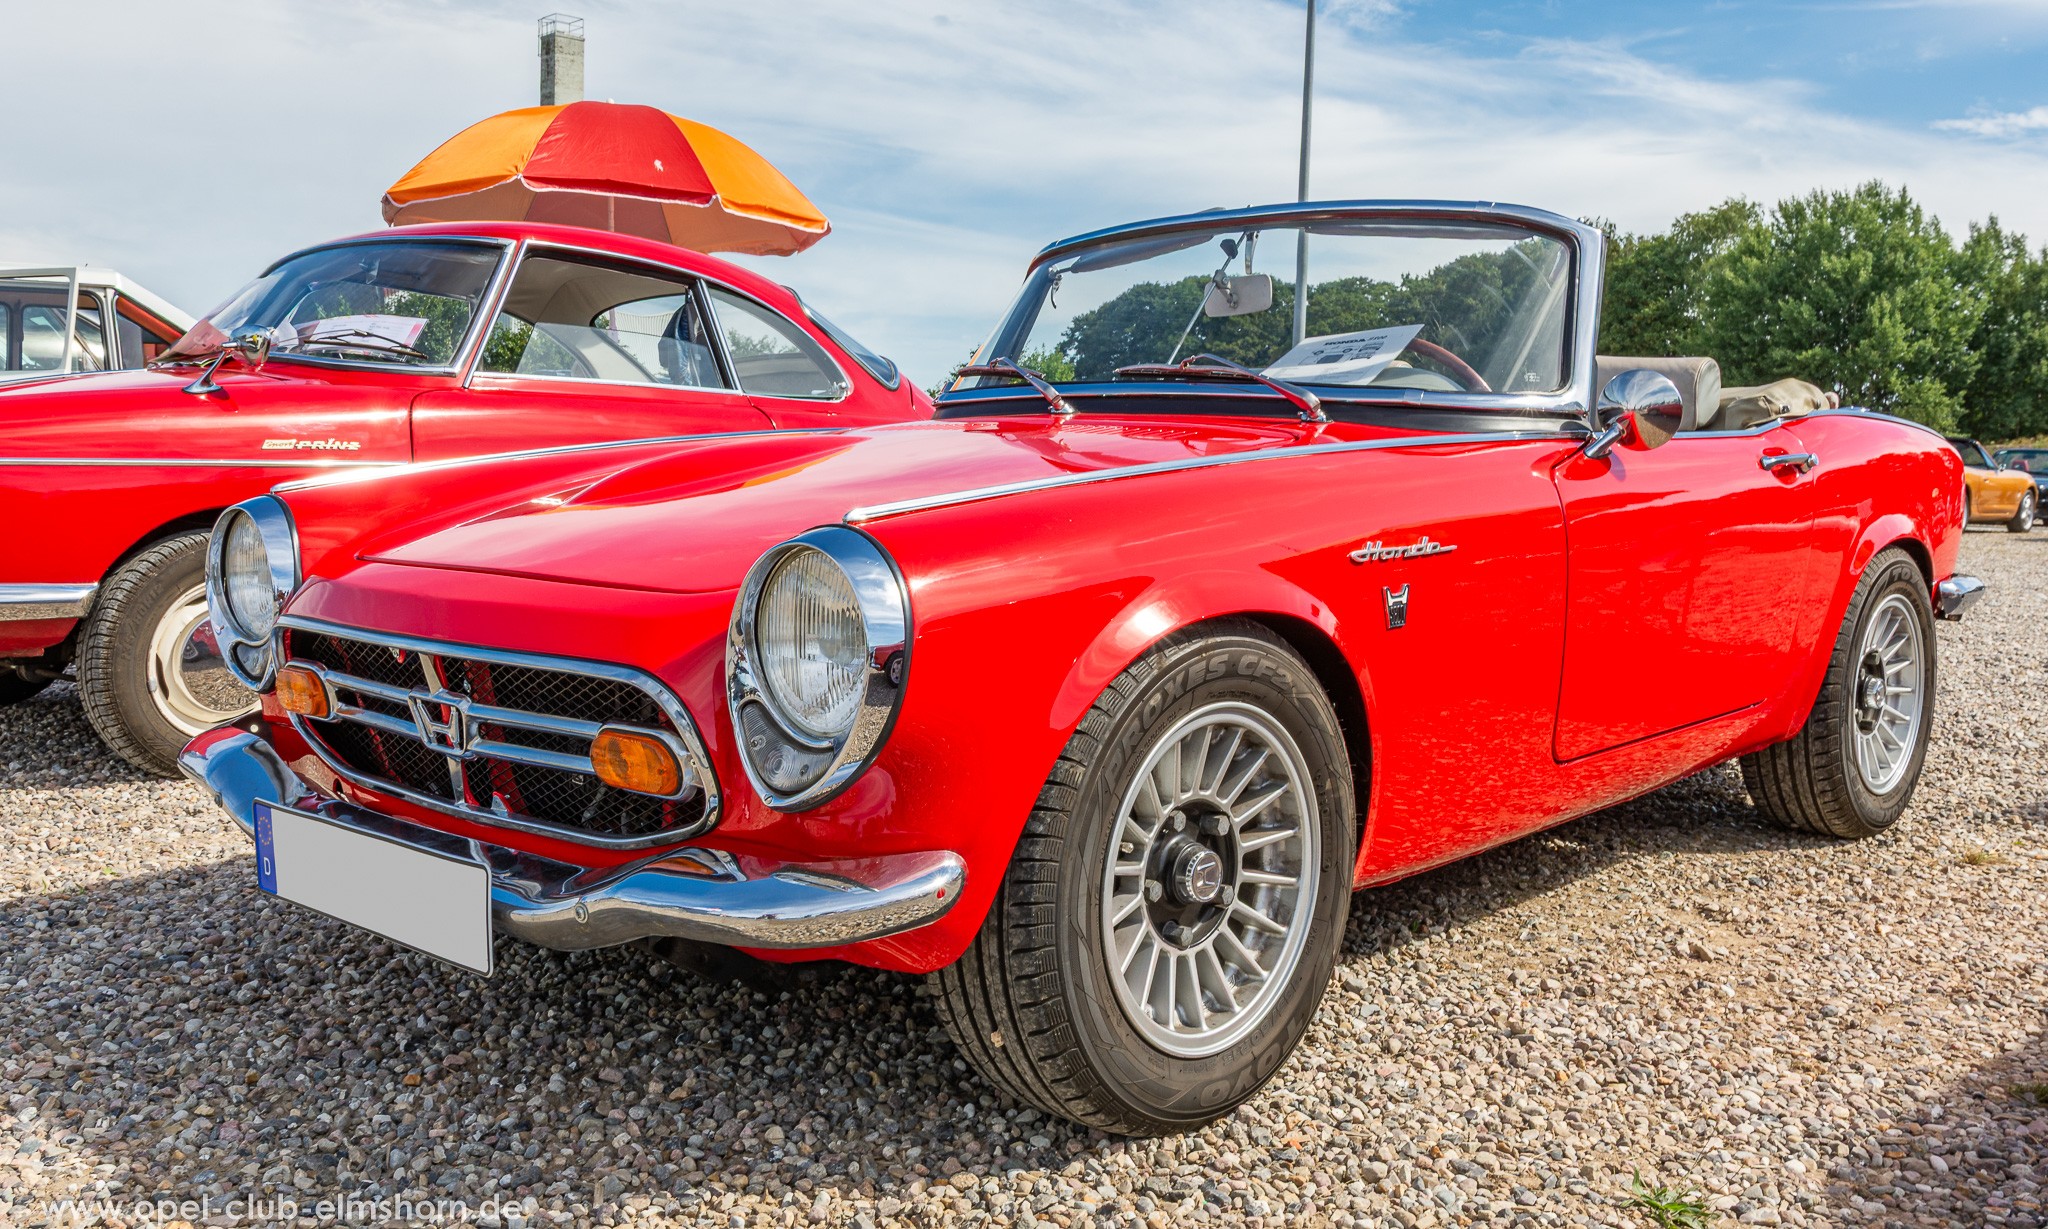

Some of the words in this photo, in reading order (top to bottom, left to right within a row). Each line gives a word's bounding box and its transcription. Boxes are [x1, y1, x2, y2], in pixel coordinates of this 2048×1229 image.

[1347, 536, 1458, 563] Honda
[1103, 653, 1230, 783] PROXES
[1236, 654, 1295, 694] CF2
[263, 856, 271, 876] D
[1199, 1016, 1305, 1107] TOYO
